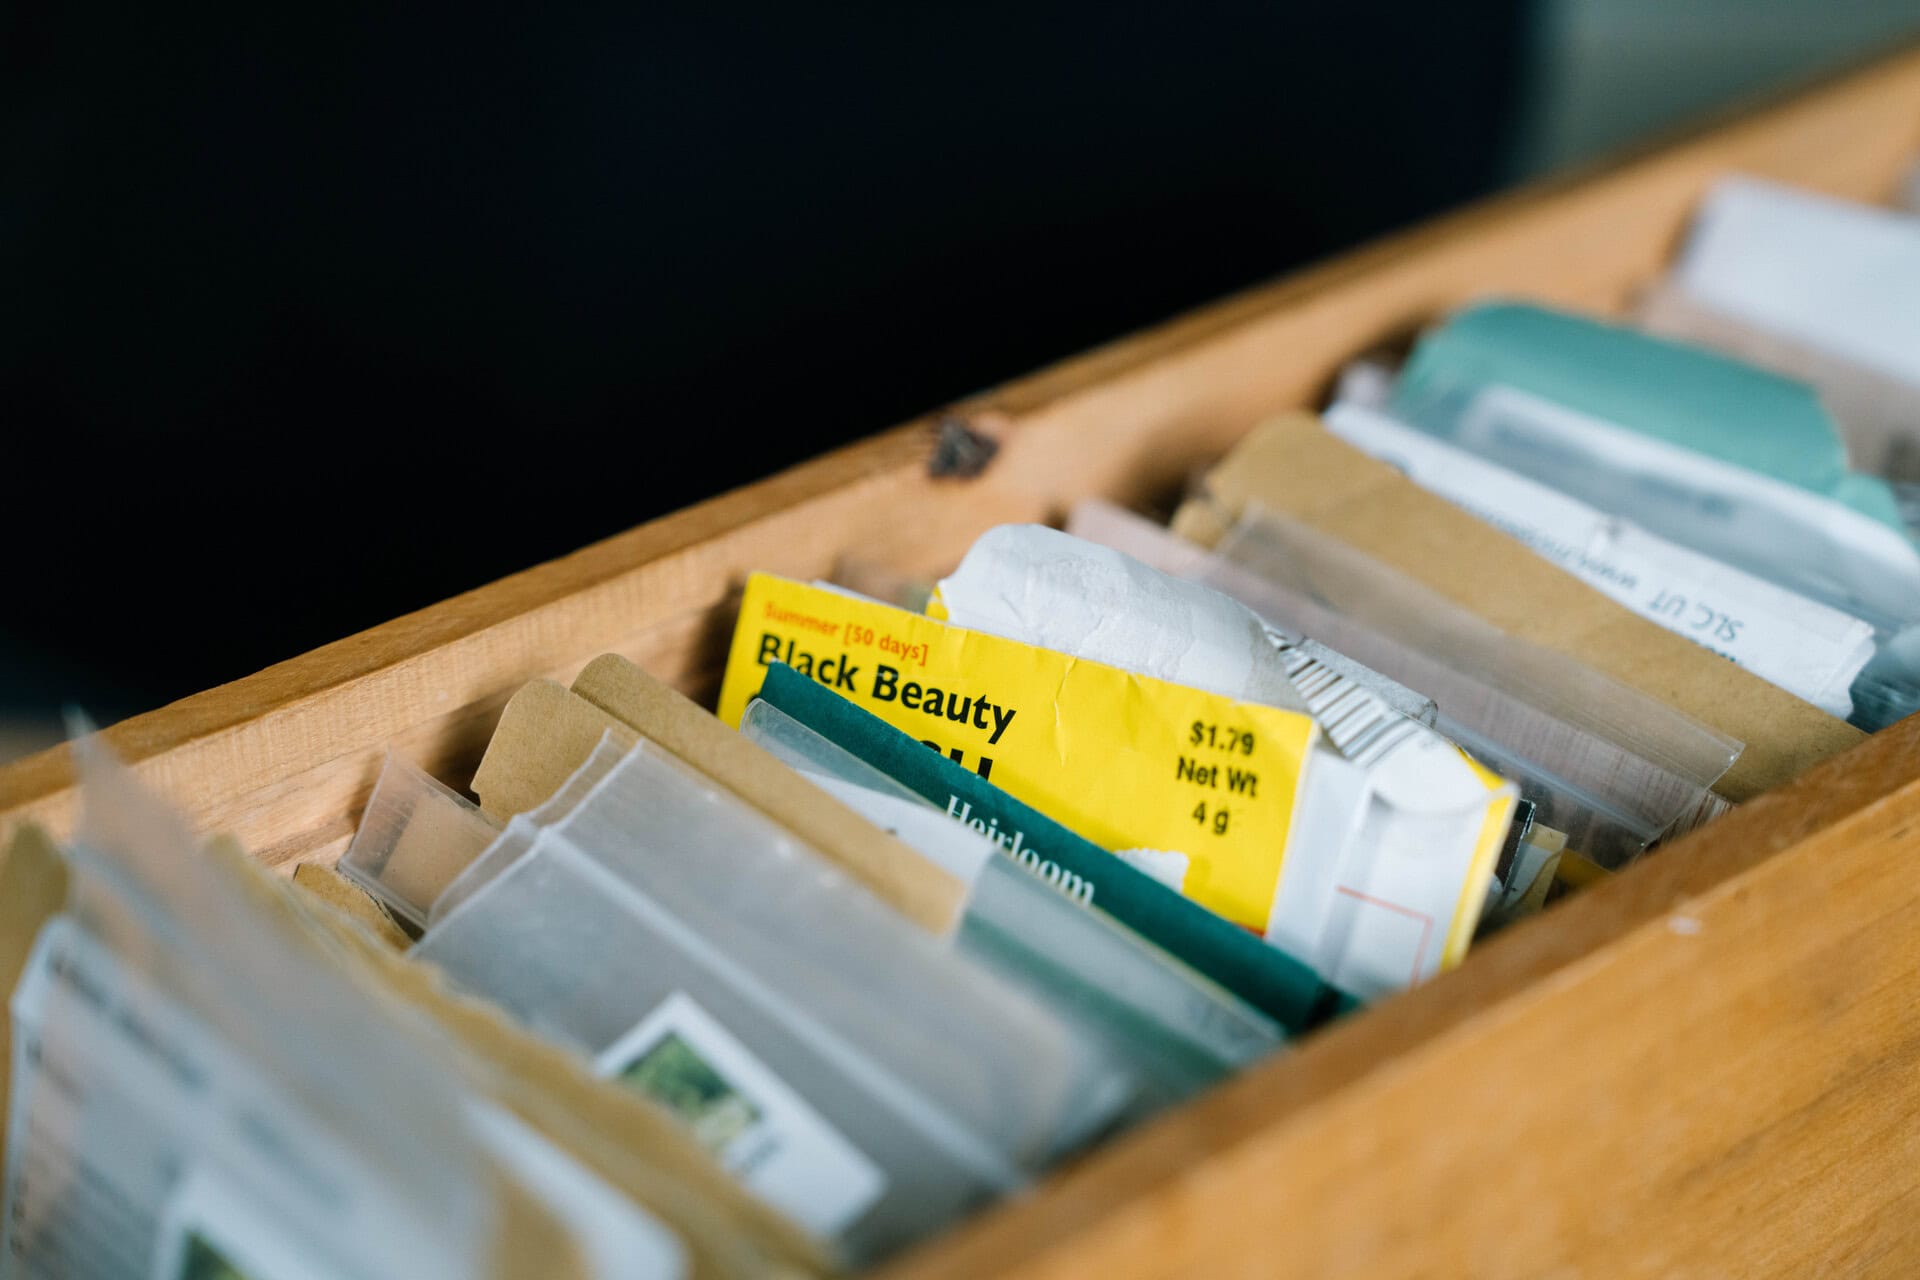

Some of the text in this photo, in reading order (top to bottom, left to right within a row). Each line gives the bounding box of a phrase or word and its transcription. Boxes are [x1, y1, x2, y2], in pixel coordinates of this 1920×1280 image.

[765, 601, 930, 668] Summer [50 days]
[1649, 588, 1745, 642] SLC UT
[757, 633, 1017, 745] Black Beauty
[1189, 720, 1256, 757] $1.79
[1176, 756, 1258, 798] Net Wt
[1192, 801, 1230, 836] 4 g
[946, 794, 1096, 906] Heirloom
